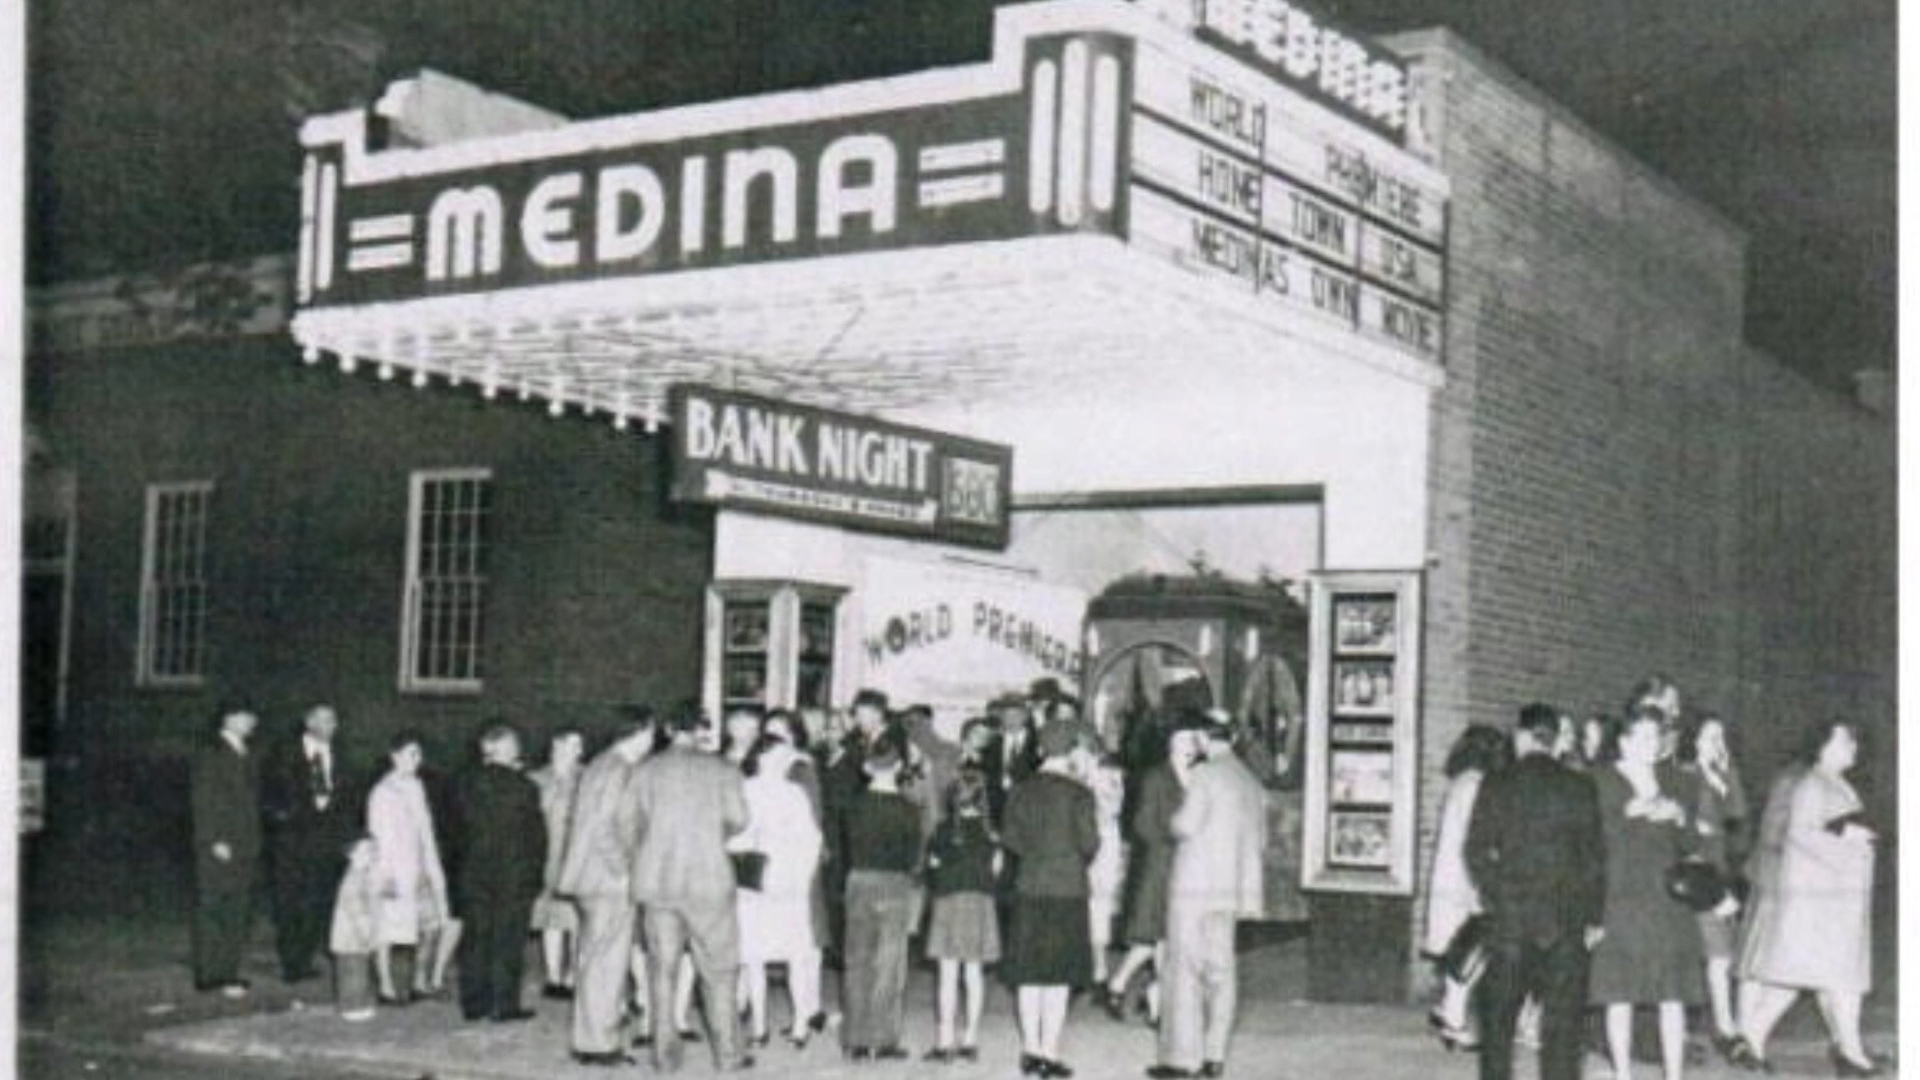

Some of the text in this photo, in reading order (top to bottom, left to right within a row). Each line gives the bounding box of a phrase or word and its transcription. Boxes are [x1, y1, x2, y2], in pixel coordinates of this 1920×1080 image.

[1188, 78, 1264, 148] WORLD
[426, 134, 897, 281] MEDINA
[1289, 191, 1344, 254] TOWN
[687, 398, 934, 491] BANK NIGHT
[862, 603, 951, 667] WORLD
